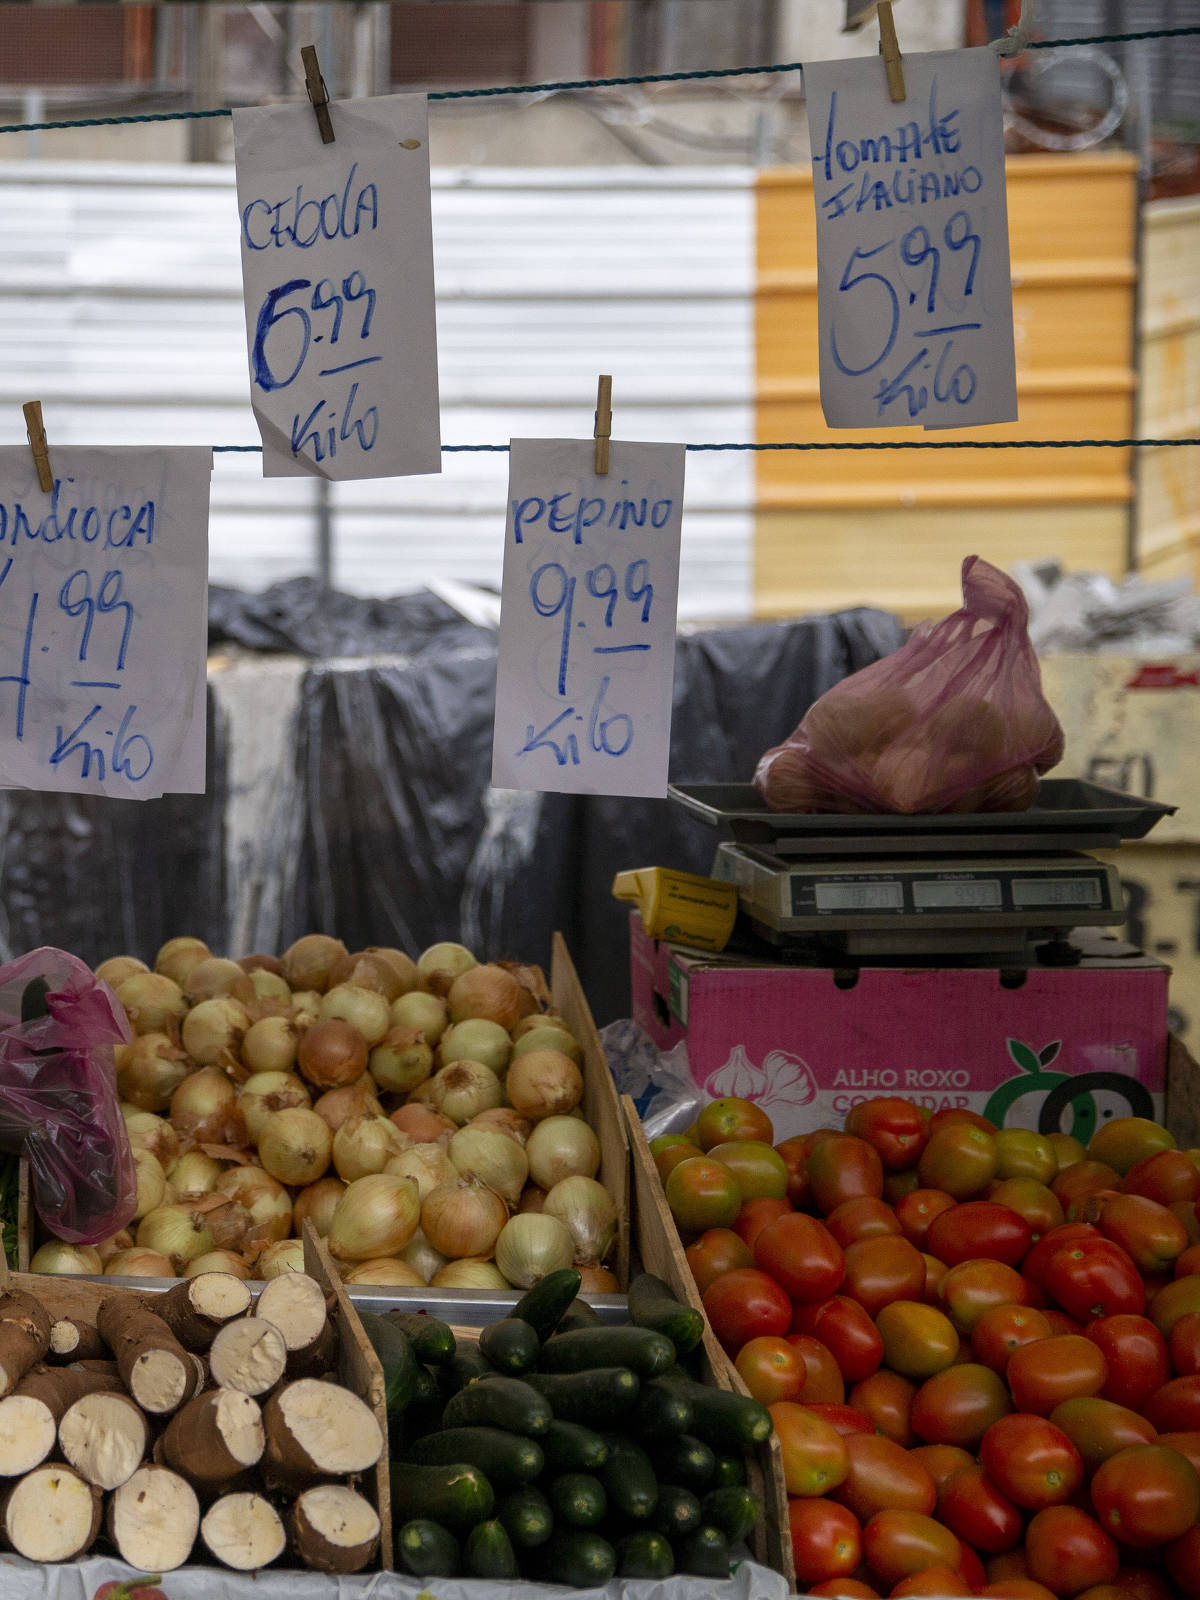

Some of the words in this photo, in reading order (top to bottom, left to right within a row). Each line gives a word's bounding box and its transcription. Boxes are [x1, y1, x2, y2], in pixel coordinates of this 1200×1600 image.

[252, 269, 377, 393] 6.99
[831, 210, 982, 377] 5.99
[529, 558, 654, 697] 9.99
[832, 1068, 898, 1088] ALHO
[905, 1068, 971, 1088] ROXO
